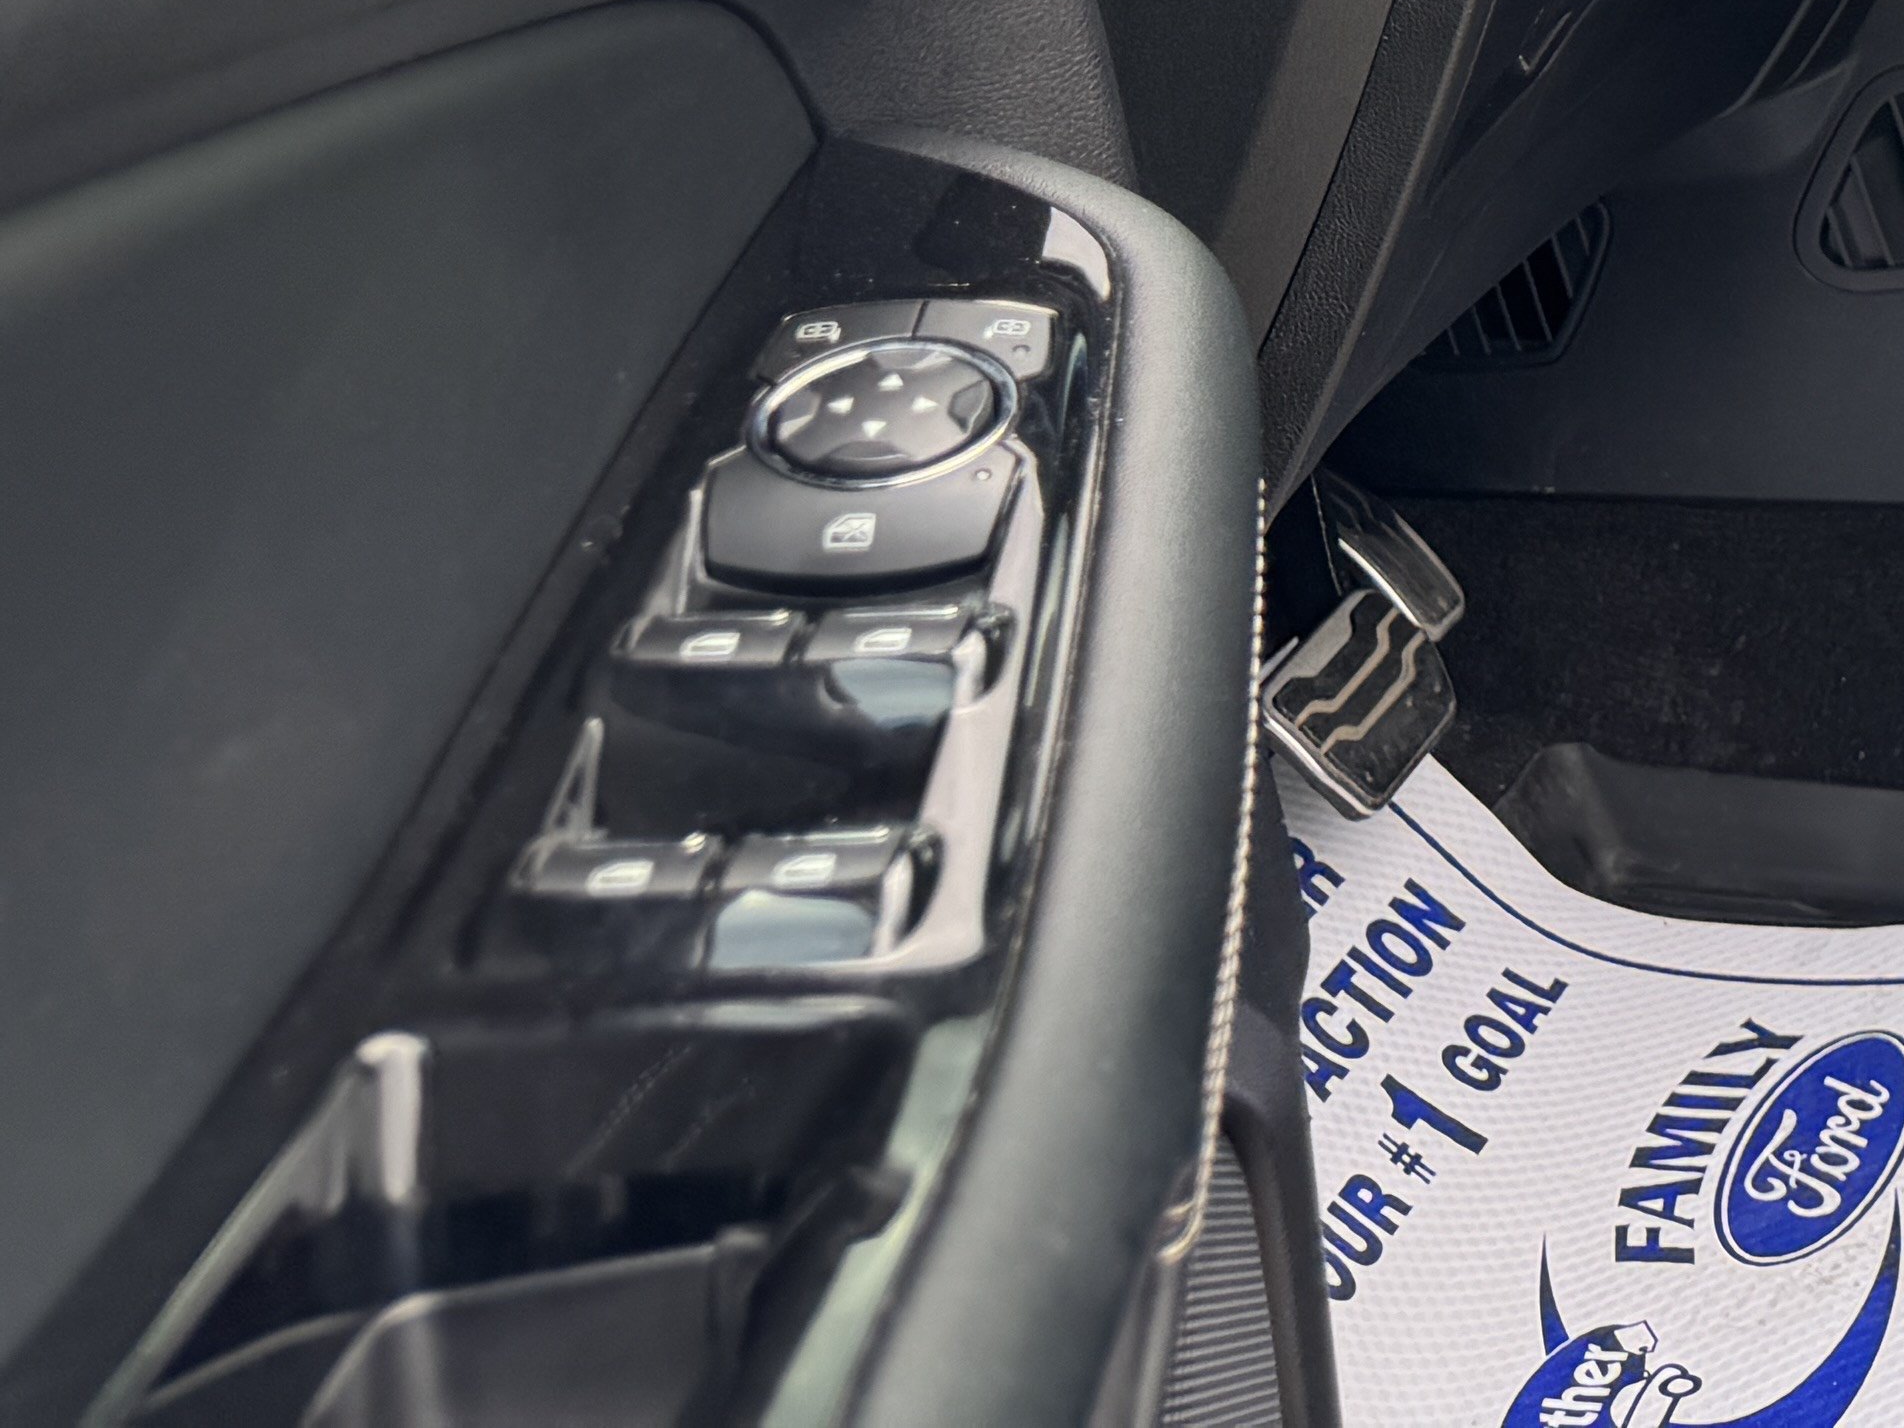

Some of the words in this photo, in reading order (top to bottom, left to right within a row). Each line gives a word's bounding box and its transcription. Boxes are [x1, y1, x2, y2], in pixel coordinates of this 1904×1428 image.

[1442, 967, 1569, 1092] GOAL
[1615, 1016, 1804, 1265] FAMILY
[1744, 1076, 1891, 1217] Ford
